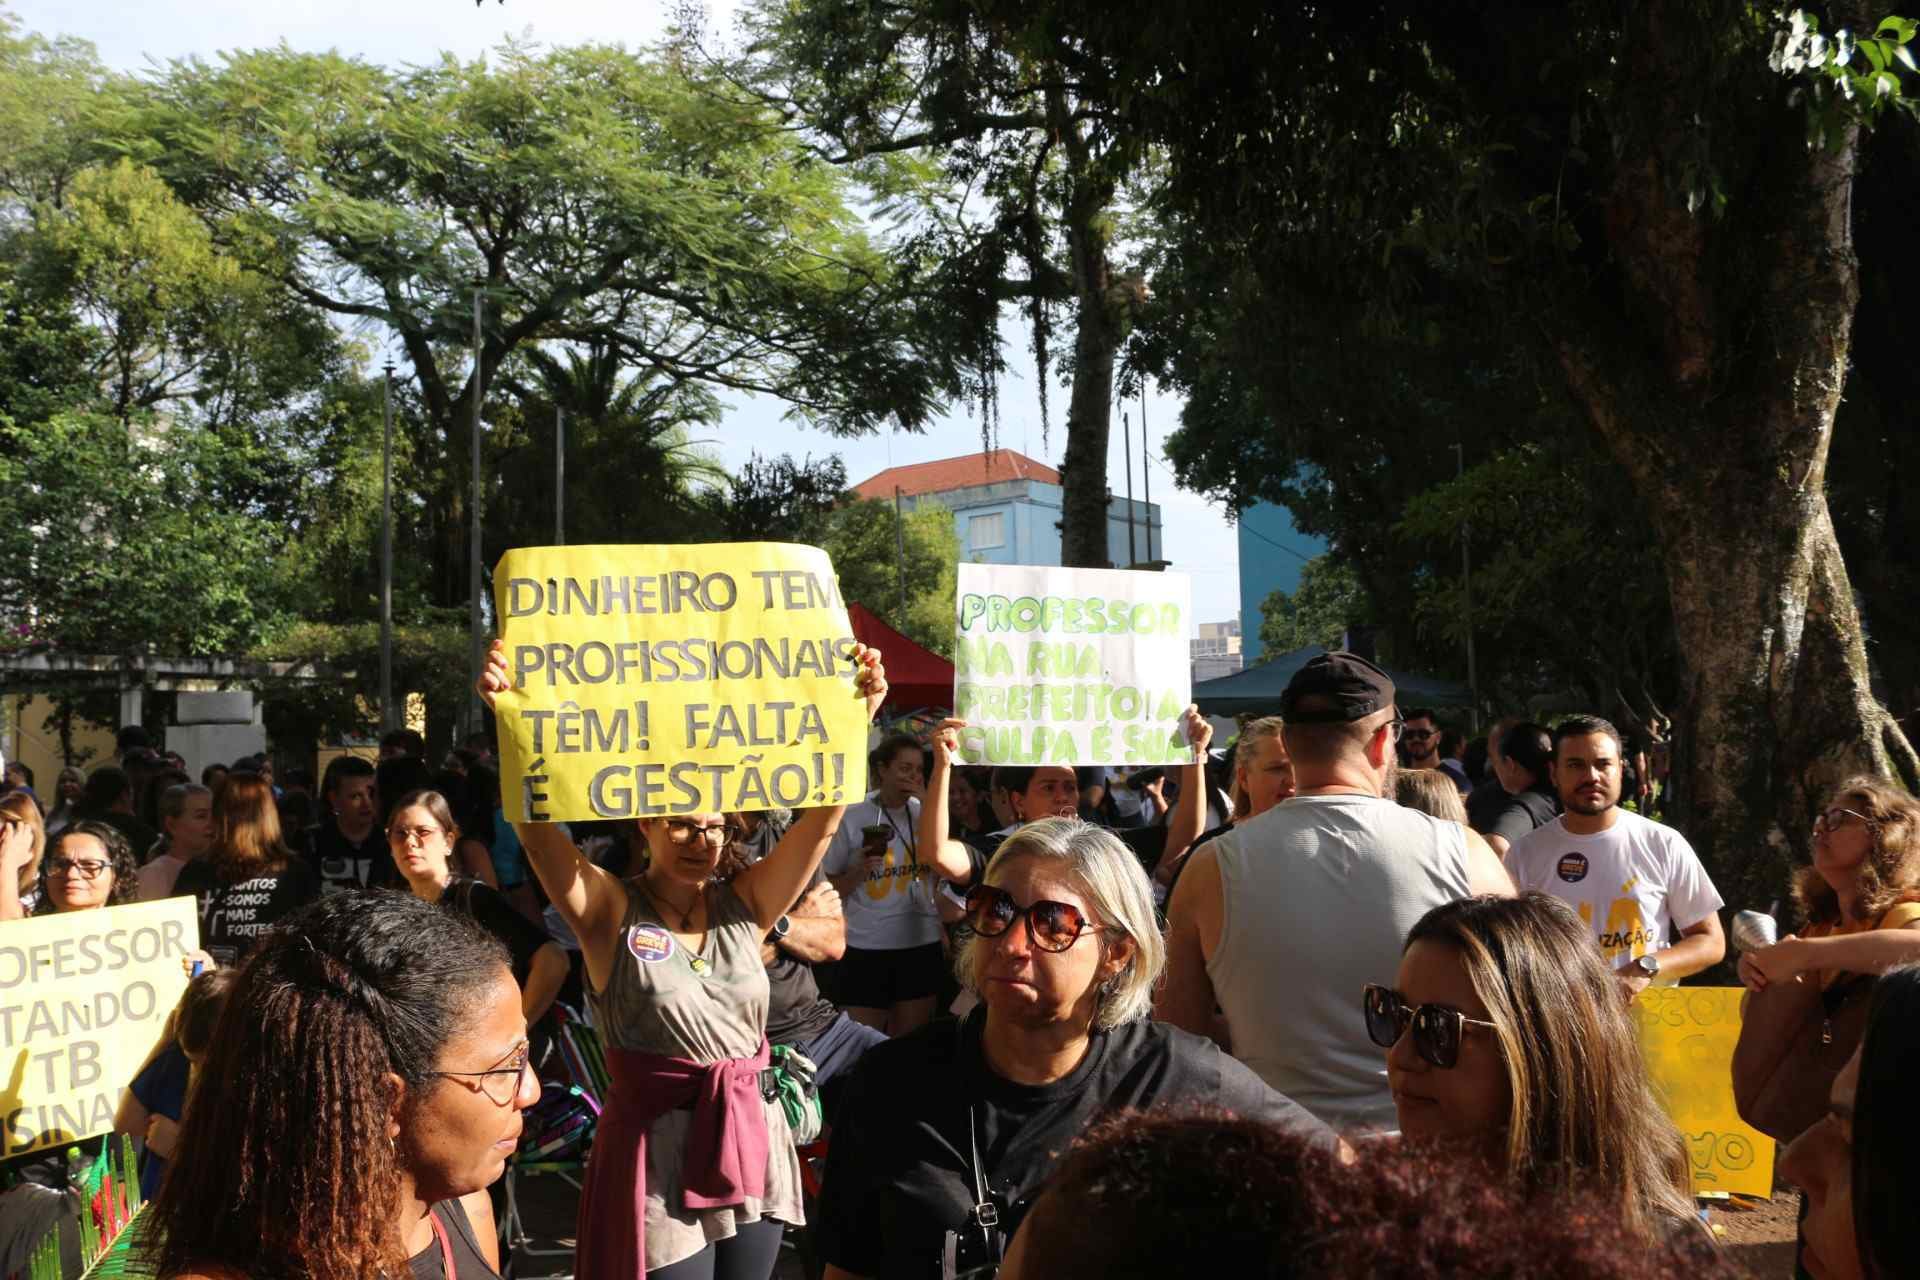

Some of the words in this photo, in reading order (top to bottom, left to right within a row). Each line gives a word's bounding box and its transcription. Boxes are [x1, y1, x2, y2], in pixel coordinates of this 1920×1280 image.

[506, 570, 738, 618] DINHEIRO
[752, 570, 842, 611] TEM
[960, 594, 1181, 636] PROFESSOR
[515, 636, 859, 688] PROFISSIONAIS
[956, 634, 1015, 677] NA
[956, 682, 1152, 722] PREFEITO!
[521, 700, 650, 754] TÊM!
[686, 701, 830, 749] FALTA
[957, 726, 1078, 764] CULPA
[1090, 720, 1114, 762] É
[521, 757, 550, 821] É
[588, 752, 846, 818] GESTÃO!!
[225, 892, 271, 906] SOMOS
[225, 908, 256, 923] MAIS
[33, 1040, 103, 1095] TB
[0, 1088, 123, 1155] SINA
